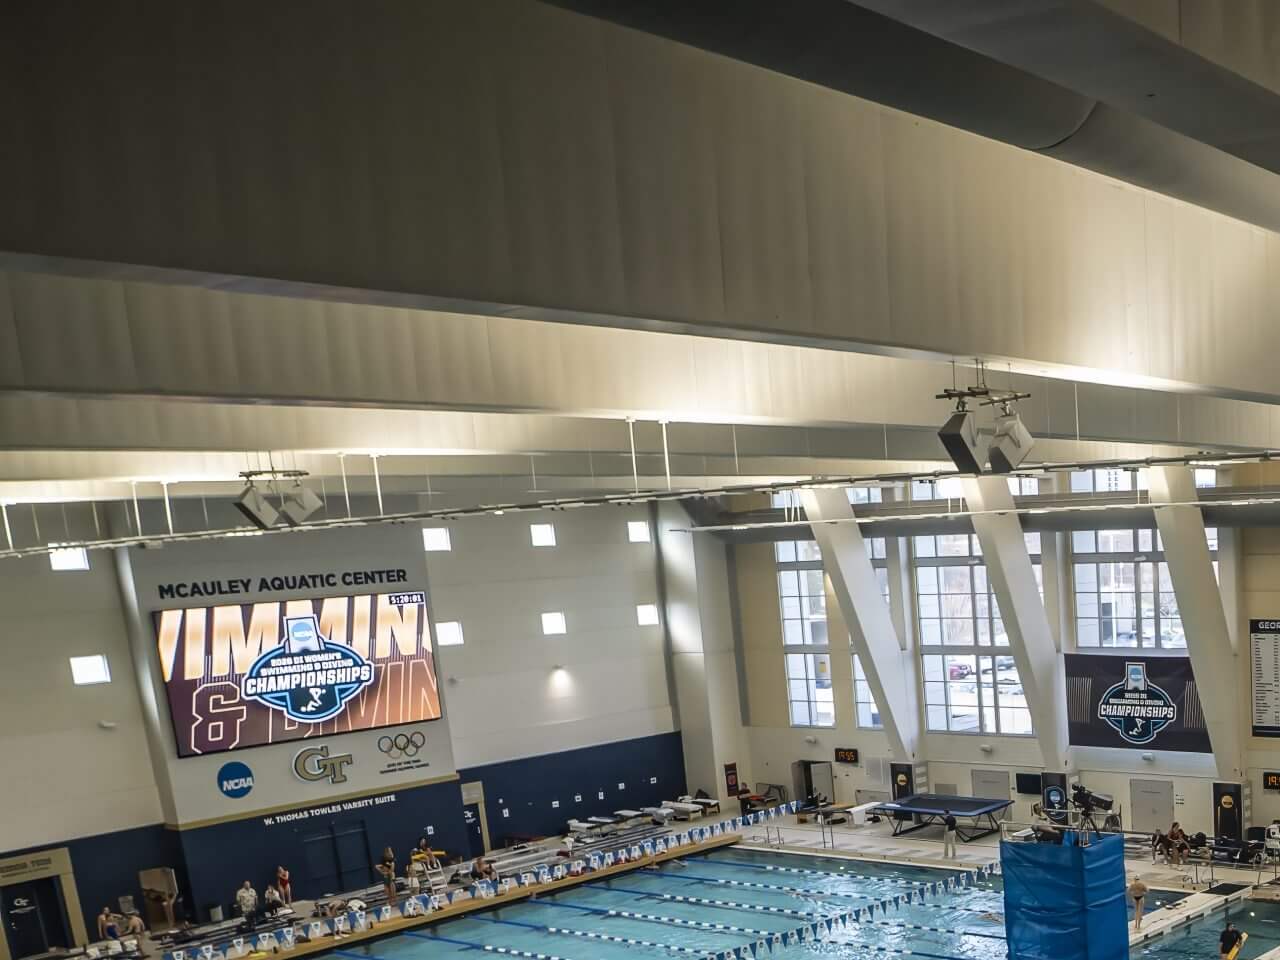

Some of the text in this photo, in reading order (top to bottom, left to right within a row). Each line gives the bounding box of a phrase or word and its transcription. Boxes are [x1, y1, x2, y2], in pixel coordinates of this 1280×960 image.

[158, 568, 408, 600] MCAULEY AQUATIC CENTER
[246, 665, 370, 694] CHAMPIONSHIPS
[1100, 704, 1174, 719] CHAMPIONSHIPS
[292, 744, 353, 785] GT
[222, 775, 254, 792] NCAA
[275, 810, 309, 824] THOMAS
[309, 804, 342, 817] TOWLES
[342, 797, 374, 811] VARSITY
[374, 794, 396, 805] SUITE
